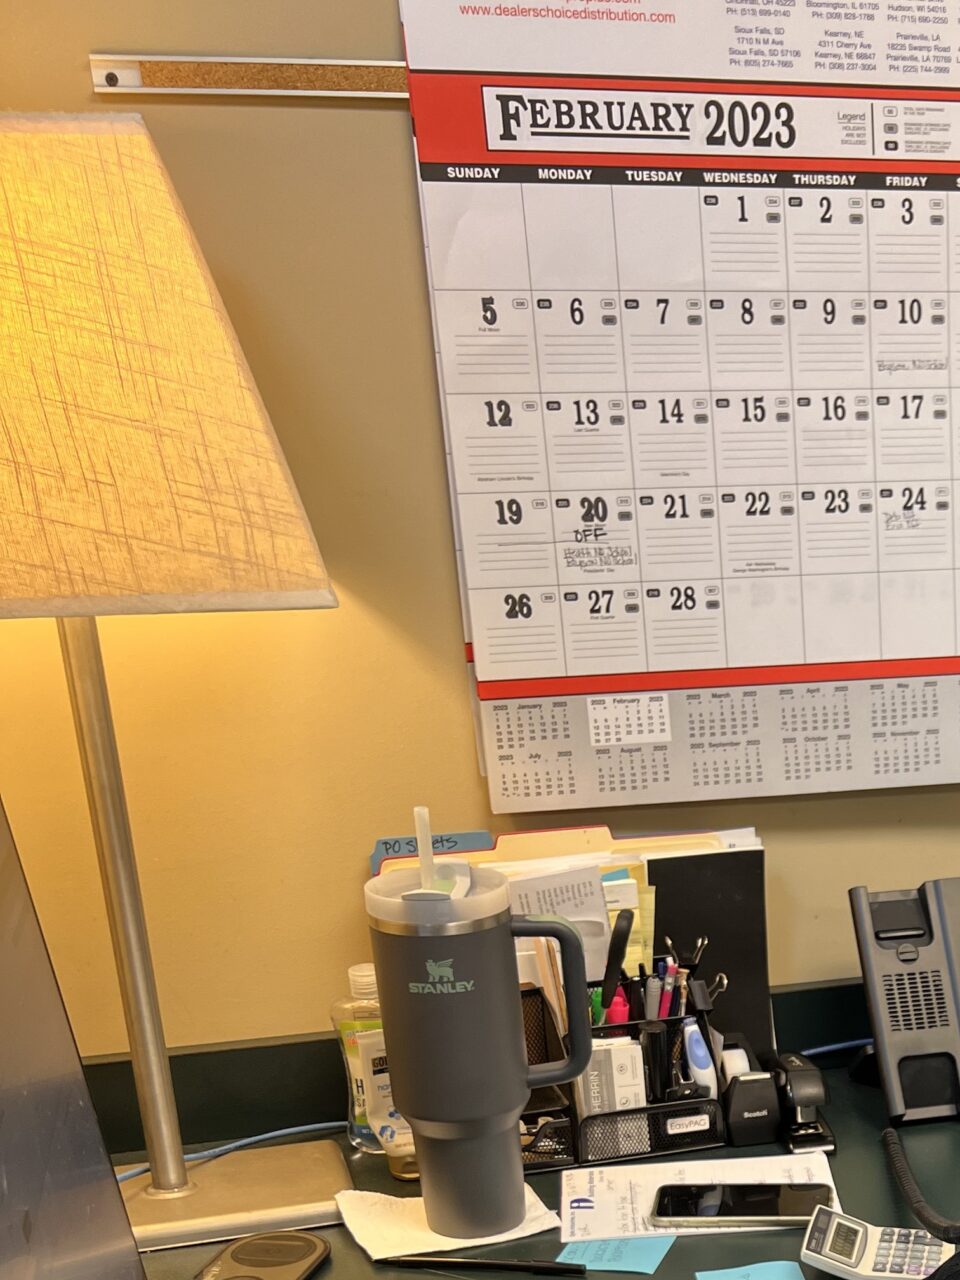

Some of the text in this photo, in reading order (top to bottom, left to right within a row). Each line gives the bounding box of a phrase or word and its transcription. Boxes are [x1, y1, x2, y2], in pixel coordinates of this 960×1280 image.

[459, 4, 676, 24] www.dealerschoicedistribution.com
[704, 99, 796, 149] 2023
[837, 111, 866, 123] Legend
[446, 167, 501, 179] SUNDAY
[538, 168, 593, 181] MONDAY
[625, 170, 683, 182] TUESDAY
[703, 172, 778, 185] WEDNESDAY
[793, 174, 857, 186] THURSDAY
[885, 176, 929, 187] FRIDAY
[738, 195, 748, 222] 1
[819, 196, 833, 223] 2
[901, 197, 914, 225] 3
[480, 296, 497, 326] 5
[570, 297, 584, 326] 6
[656, 298, 670, 325] 7
[740, 298, 754, 325] 8
[823, 298, 836, 325] 9
[898, 298, 922, 325] 10
[484, 399, 513, 427] 12
[572, 399, 600, 426] 13
[658, 398, 685, 424] 14
[741, 396, 766, 423] 15
[821, 395, 846, 421] 16
[900, 394, 924, 420] 17
[494, 498, 523, 525] 19
[580, 496, 609, 523] 20
[663, 494, 690, 519] 21
[745, 491, 771, 516] 22
[824, 489, 849, 514] 23
[901, 487, 927, 511] 24
[573, 528, 608, 543] OFF
[504, 586, 696, 619] 26 27 28
[382, 834, 458, 855] PO Sets
[408, 979, 475, 994] STANLEY
[591, 1071, 603, 1112] HERRIN
[669, 1117, 708, 1131] EasyPAG
[743, 1109, 768, 1118] Scotch
